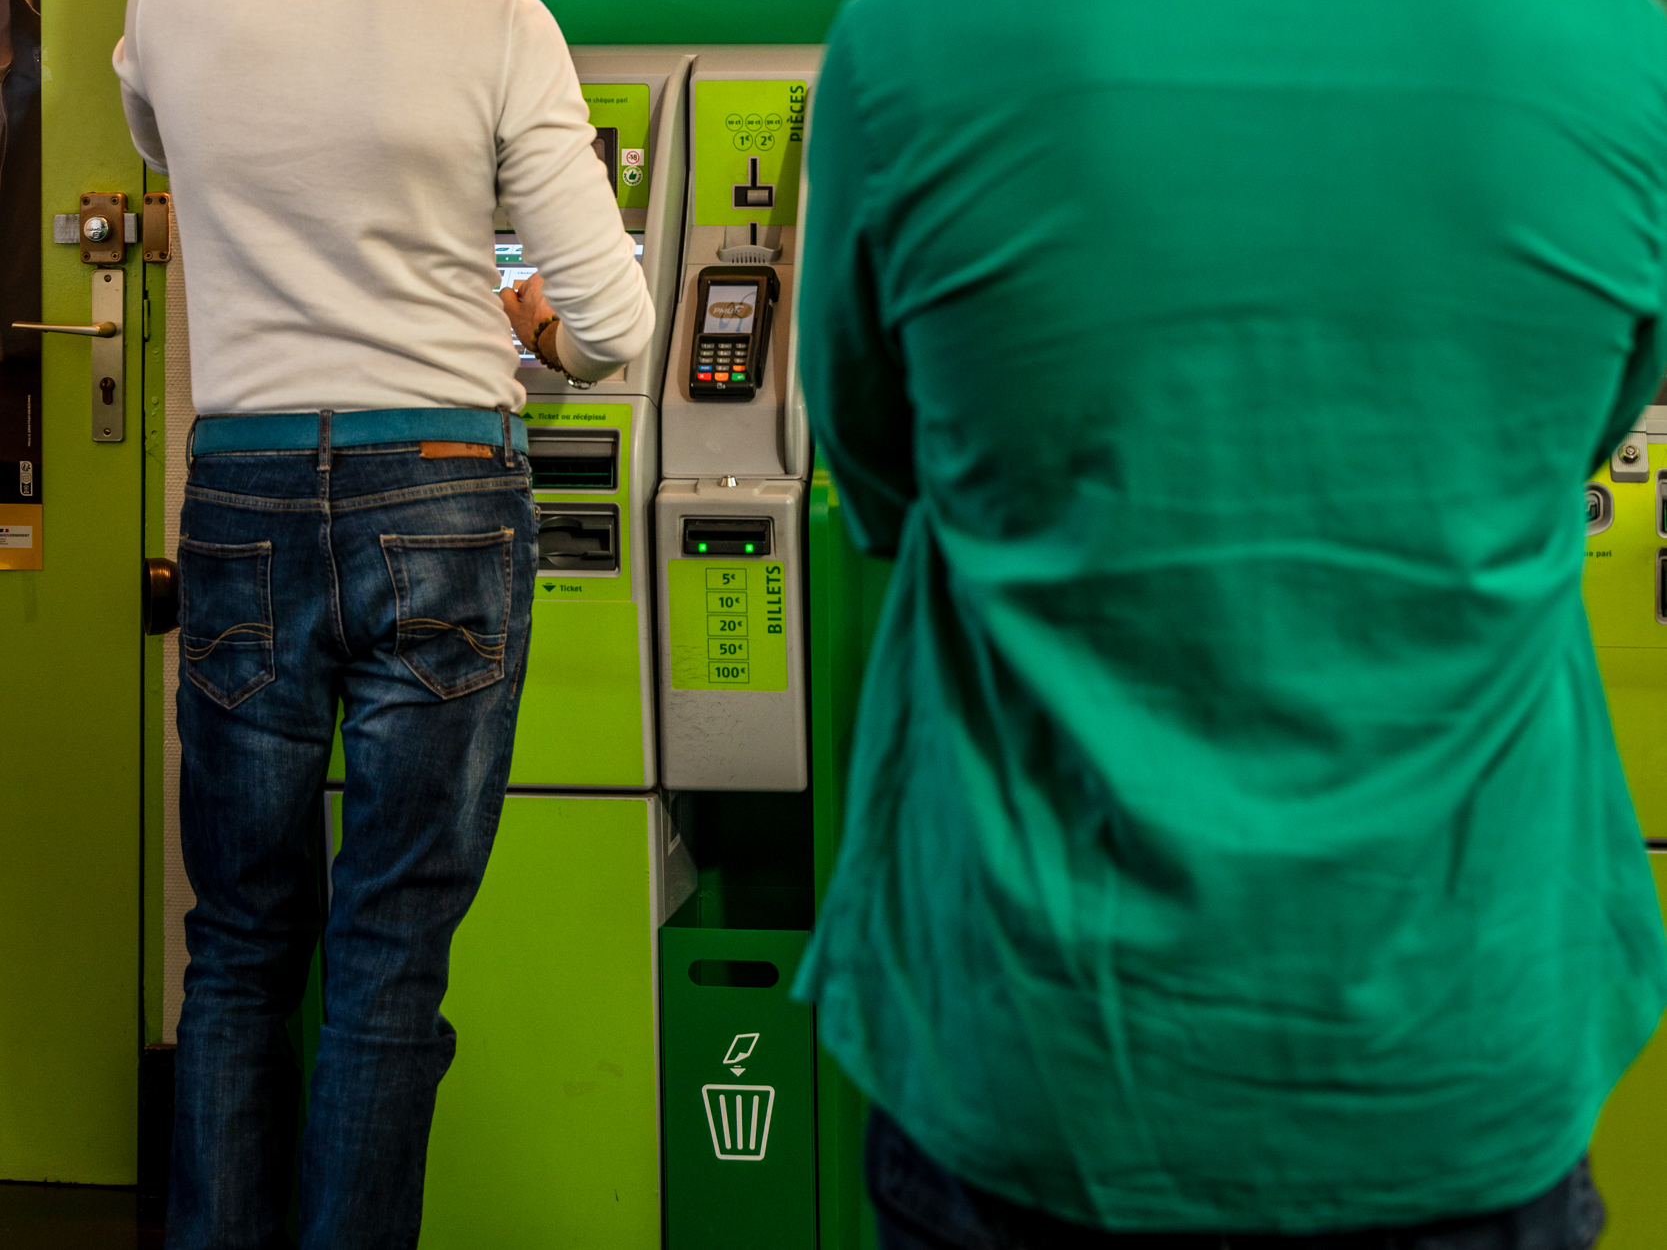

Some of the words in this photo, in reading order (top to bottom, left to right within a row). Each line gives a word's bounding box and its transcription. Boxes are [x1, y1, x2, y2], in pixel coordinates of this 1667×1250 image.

[593, 96, 615, 104] chèque
[616, 96, 628, 104] pari
[786, 85, 804, 142] PIÈCES
[573, 413, 606, 422] récépissé
[1596, 550, 1612, 558] pari
[722, 573, 736, 585] 5€
[560, 584, 582, 592] Ticket
[718, 596, 740, 608] 10€
[766, 565, 782, 634] BILLETS
[720, 619, 743, 631] 20€
[720, 643, 743, 655] 50€
[715, 666, 746, 678] 100€
